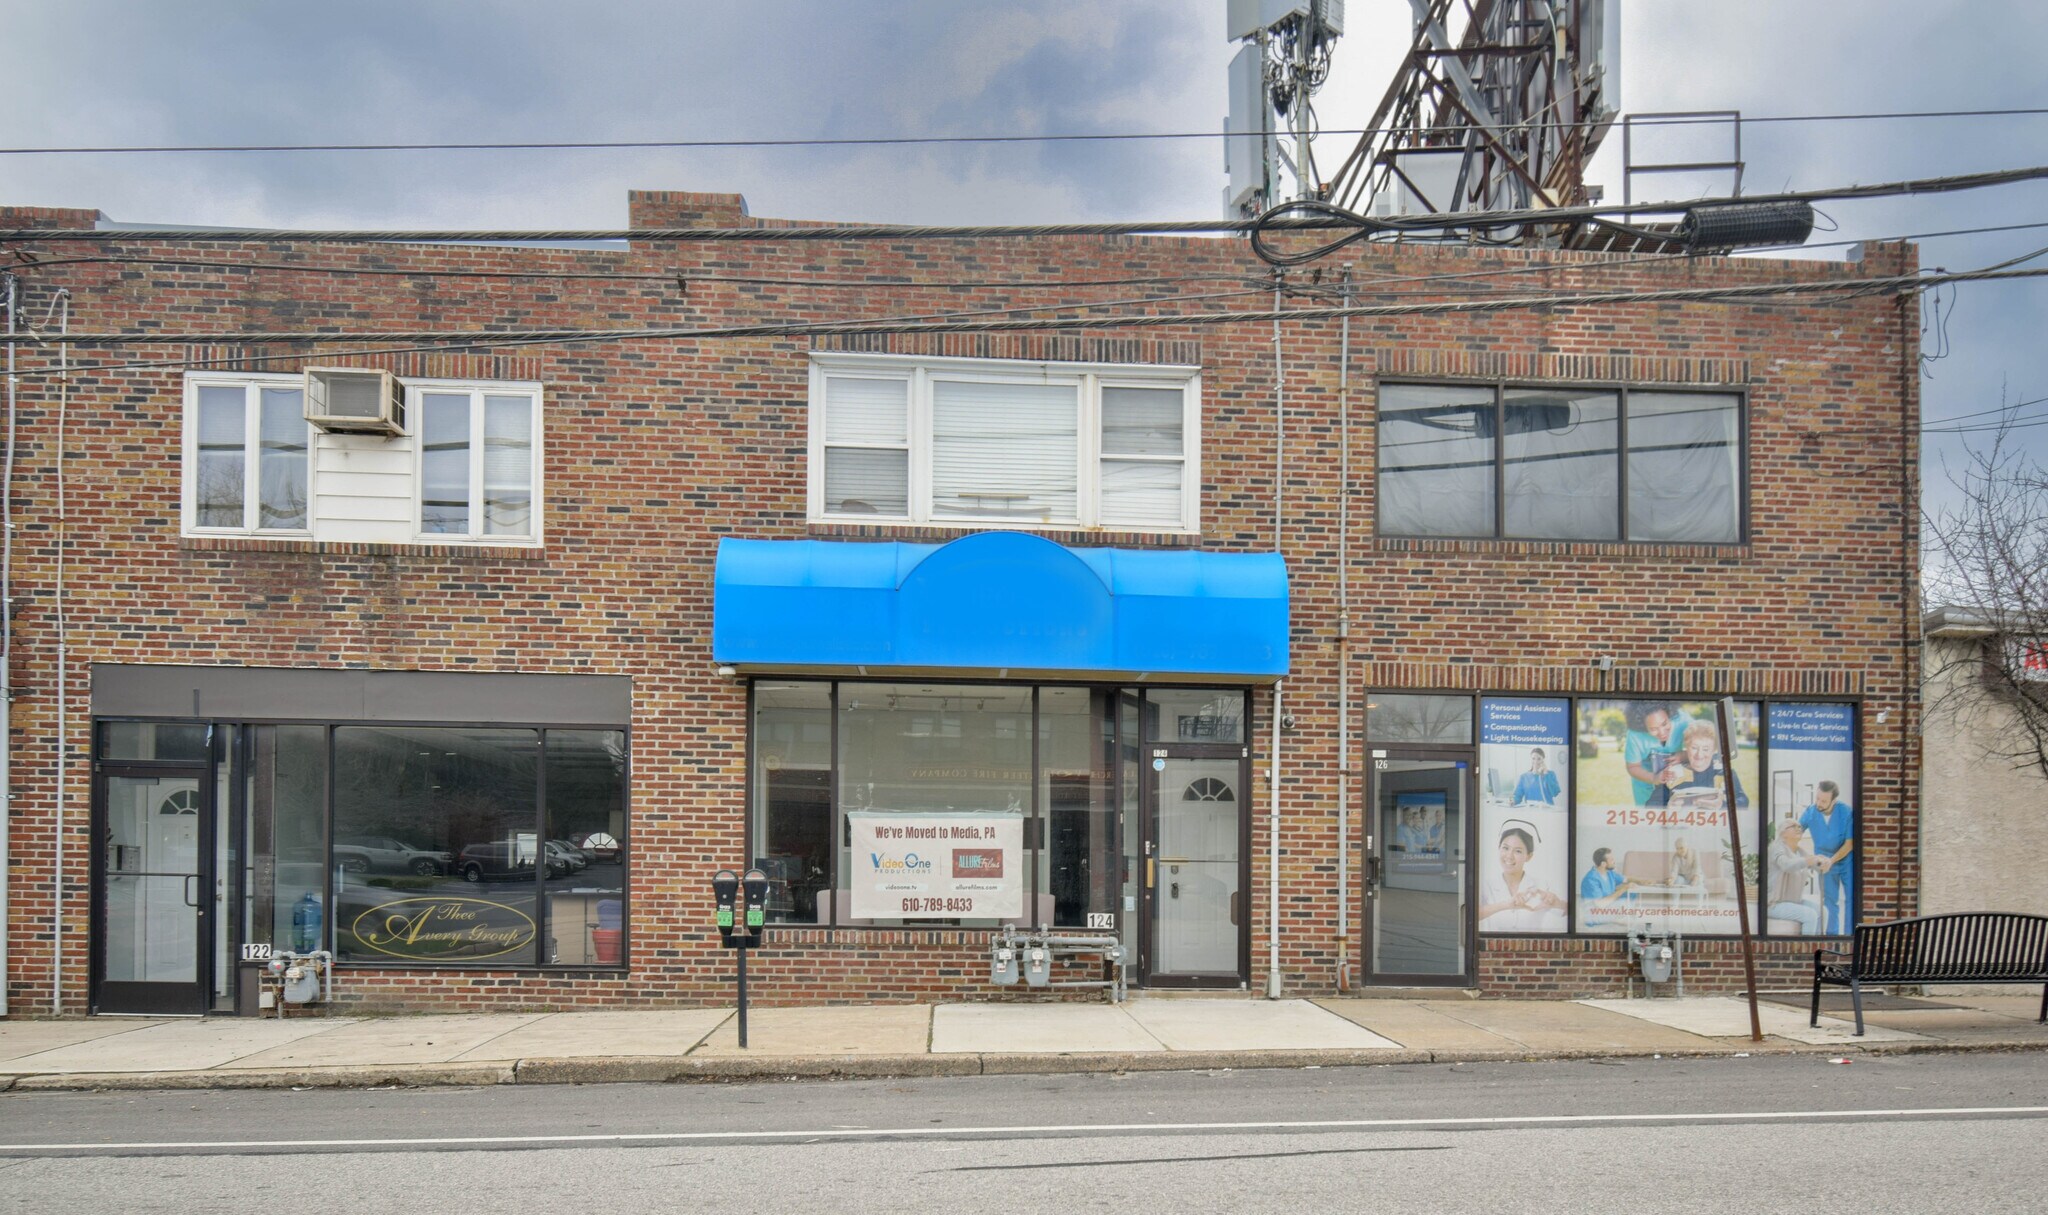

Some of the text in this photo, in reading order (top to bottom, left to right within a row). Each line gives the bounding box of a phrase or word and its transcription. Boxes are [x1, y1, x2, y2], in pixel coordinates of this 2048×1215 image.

[1490, 704, 1562, 713] Personal Assistance
[1490, 712, 1521, 720] Services
[1814, 711, 1844, 719] Services
[1490, 723, 1547, 733] Companionship
[1802, 722, 1818, 730] Care
[1820, 723, 1849, 731] Services
[1490, 734, 1564, 744] Light Housekeeping
[1790, 734, 1828, 743] Supervisor
[1830, 735, 1846, 743] Visit
[1375, 760, 1388, 769] 126
[1606, 810, 1728, 827] 215-944-4541
[875, 826, 996, 840] We've Moved to Media, PA
[902, 898, 973, 912] 610-789-8433
[437, 903, 476, 921] Thee
[1088, 914, 1113, 928] 124
[370, 905, 519, 948] Avery Group
[244, 944, 270, 959] 122
